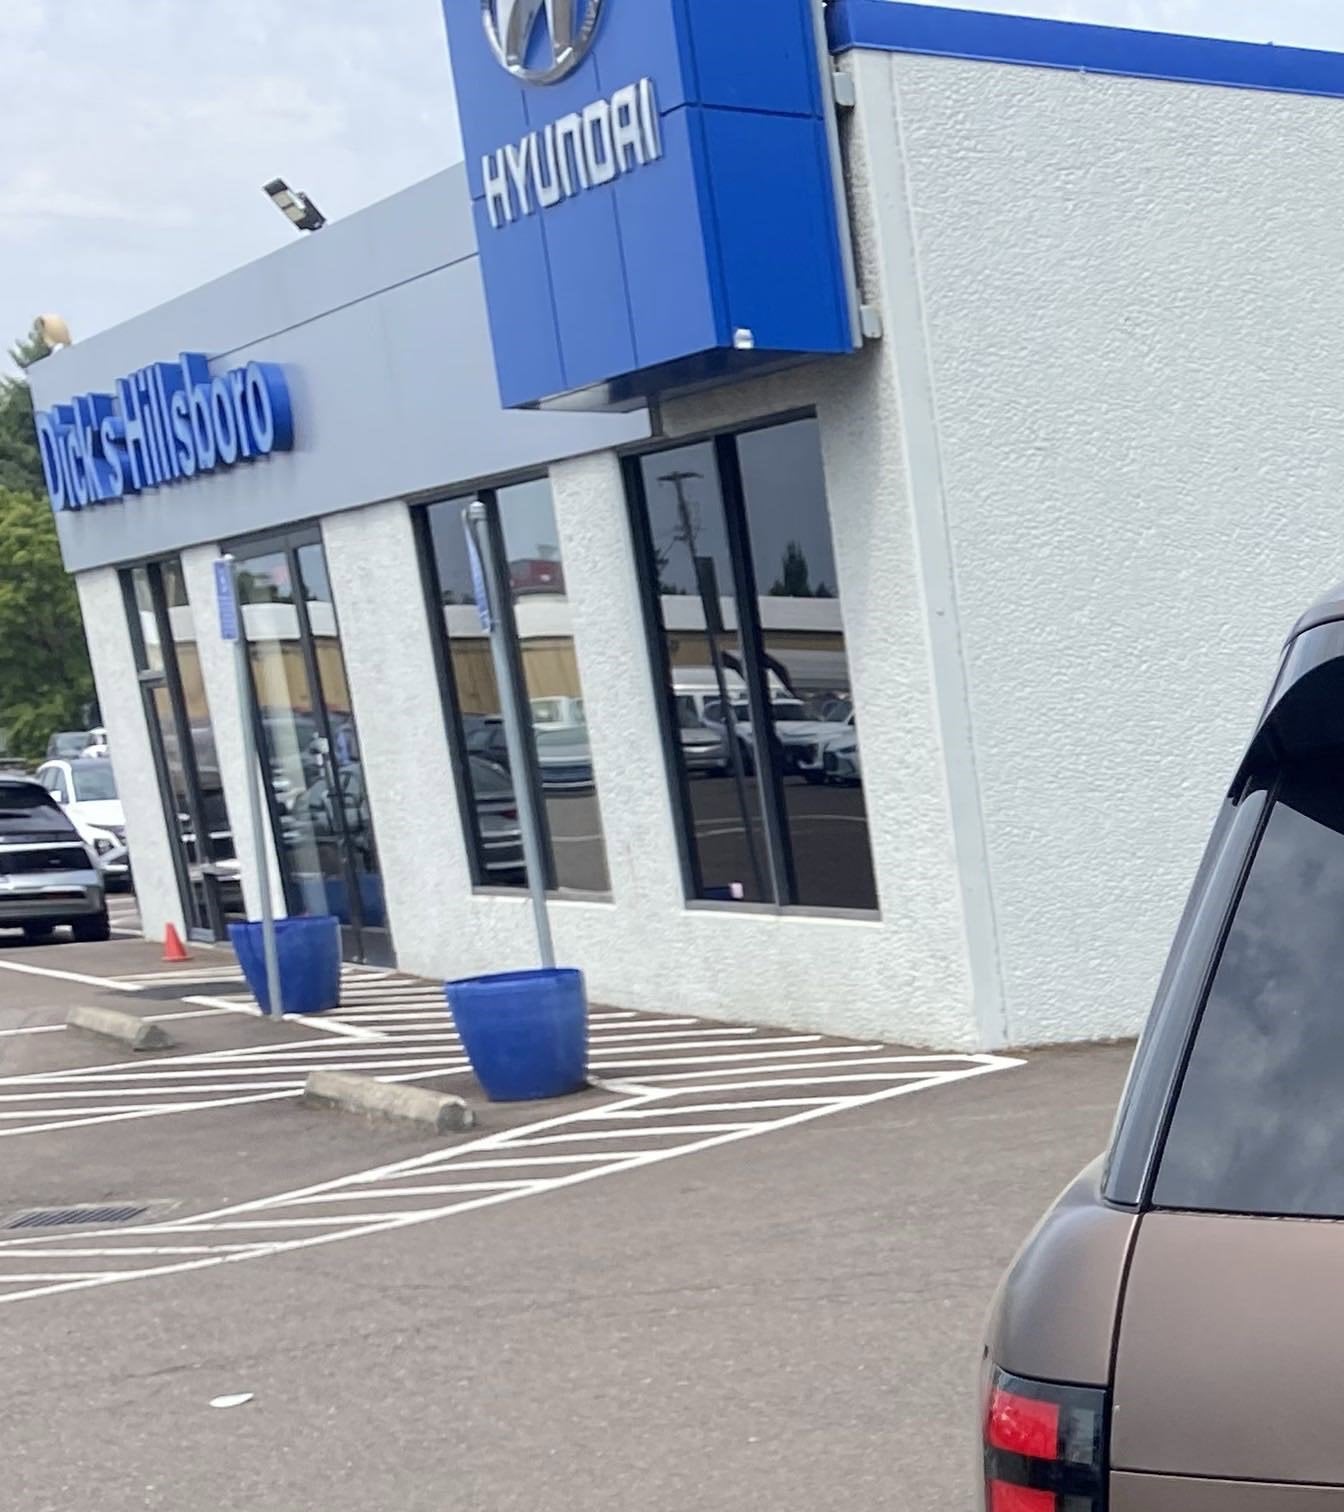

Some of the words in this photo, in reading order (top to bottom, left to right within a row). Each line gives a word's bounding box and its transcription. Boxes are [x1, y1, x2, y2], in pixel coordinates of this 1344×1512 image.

[481, 77, 662, 229] HYUNDAI
[34, 392, 124, 512] Dick's
[116, 351, 284, 490] Hillsboro
